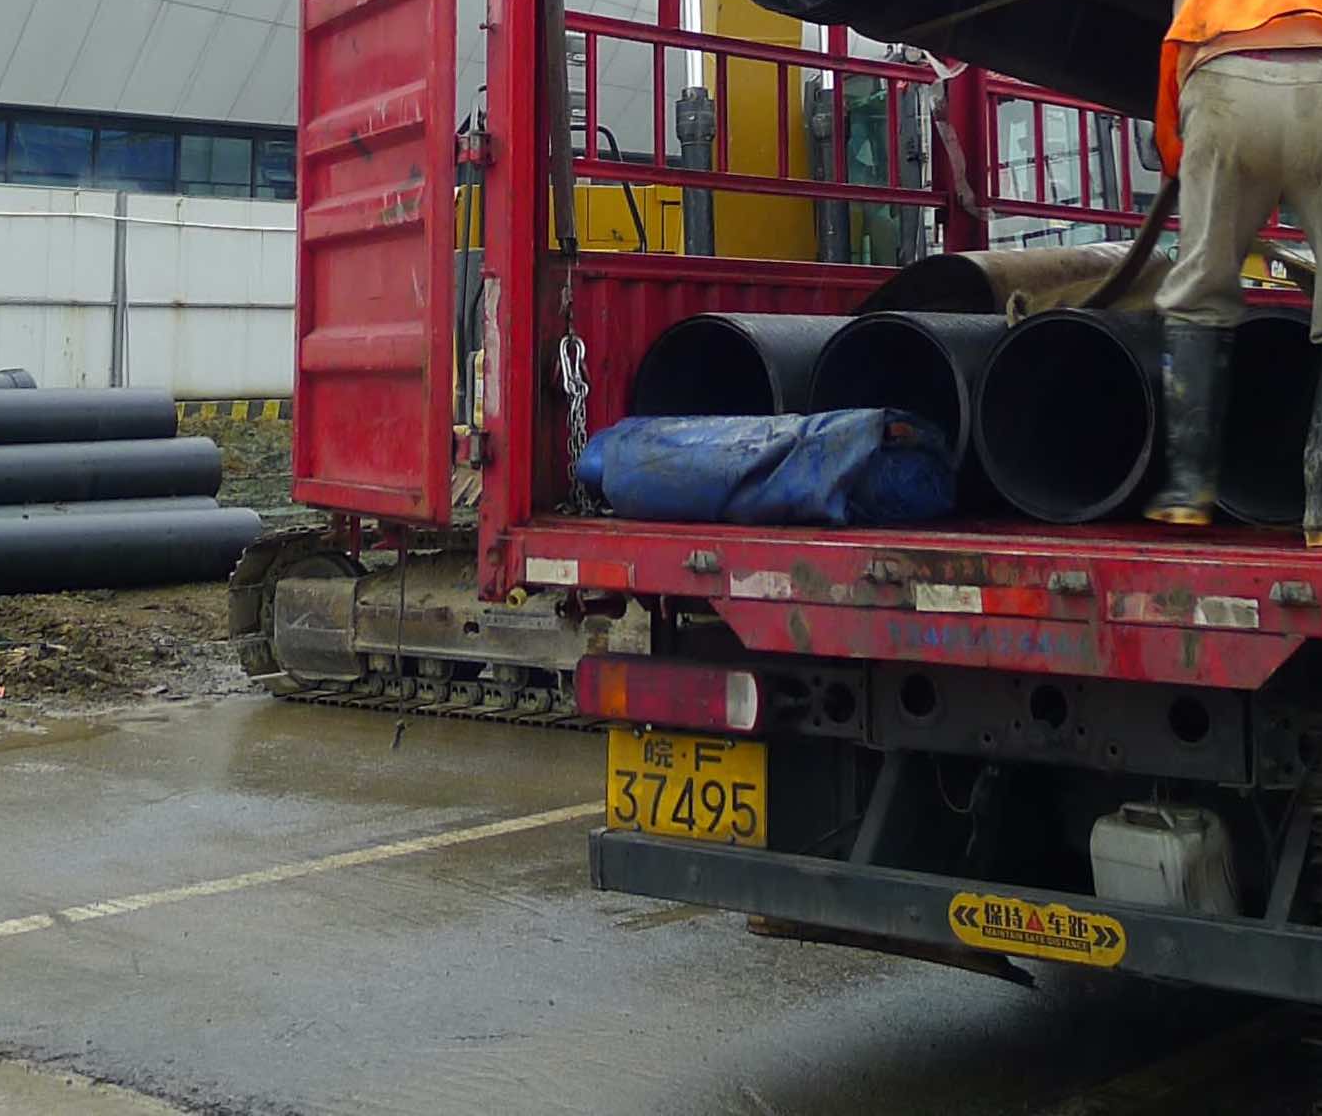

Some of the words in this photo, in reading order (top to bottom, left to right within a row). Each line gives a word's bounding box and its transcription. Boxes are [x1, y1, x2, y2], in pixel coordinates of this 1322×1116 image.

[613, 769, 758, 838] 37495
[983, 902, 1024, 930] 保持
[1048, 911, 1089, 938] 车距
